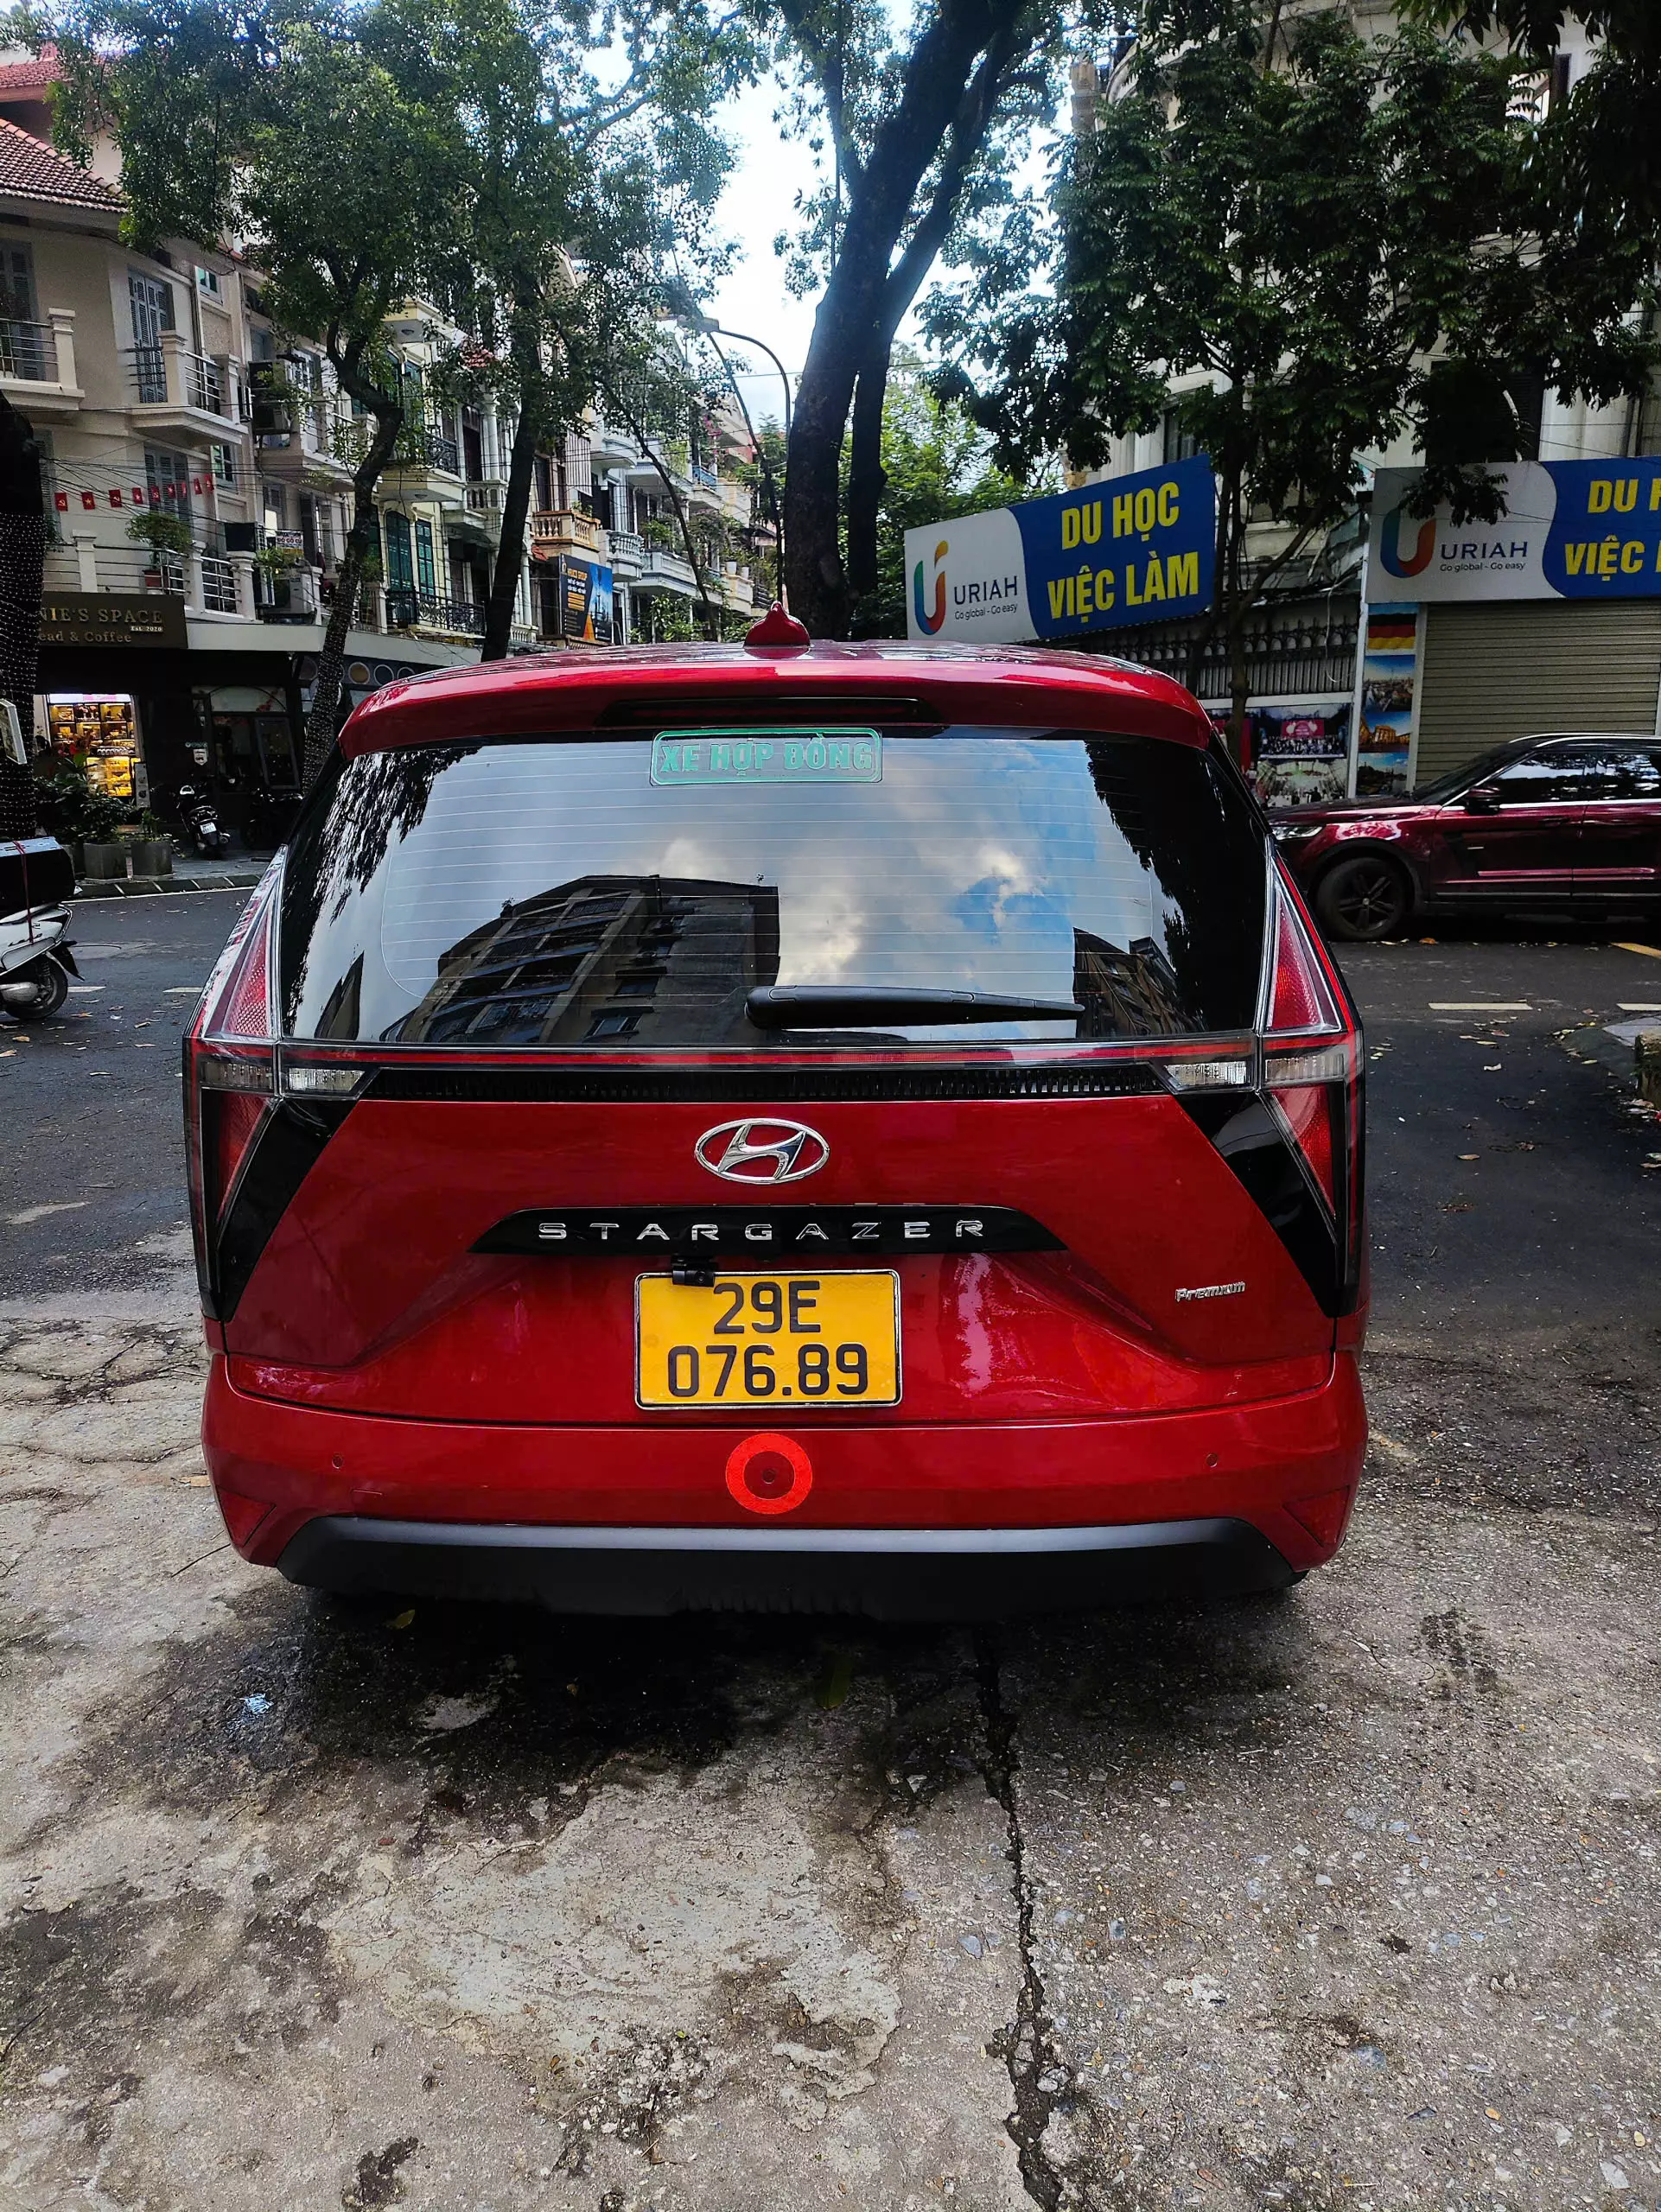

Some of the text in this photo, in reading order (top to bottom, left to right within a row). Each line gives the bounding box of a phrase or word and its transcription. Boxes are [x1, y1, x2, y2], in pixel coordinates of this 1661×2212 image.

[1587, 478, 1639, 513] DU
[1061, 481, 1180, 550] DU HỌC
[1441, 541, 1528, 560] URIAH
[1564, 534, 1645, 582] VIỆC
[1439, 563, 1452, 572] Go
[1454, 562, 1483, 573] global
[1490, 562, 1503, 570] Go
[1505, 562, 1526, 571] easy
[953, 575, 1018, 606] URIAH
[1047, 550, 1200, 623] VIỆC LÀM
[98, 608, 162, 623] SPACE
[955, 610, 964, 620] Go
[964, 606, 986, 620] global
[990, 605, 1001, 614] Go
[1002, 603, 1018, 613] easy
[70, 631, 80, 642] &
[84, 631, 132, 643] Coffee
[660, 732, 873, 776] XE HỢP ĐỒNG
[538, 1218, 984, 1243] STARGAZER
[712, 1280, 821, 1334] 29E
[1175, 1281, 1245, 1303] Premium
[668, 1343, 869, 1397] 076.89
